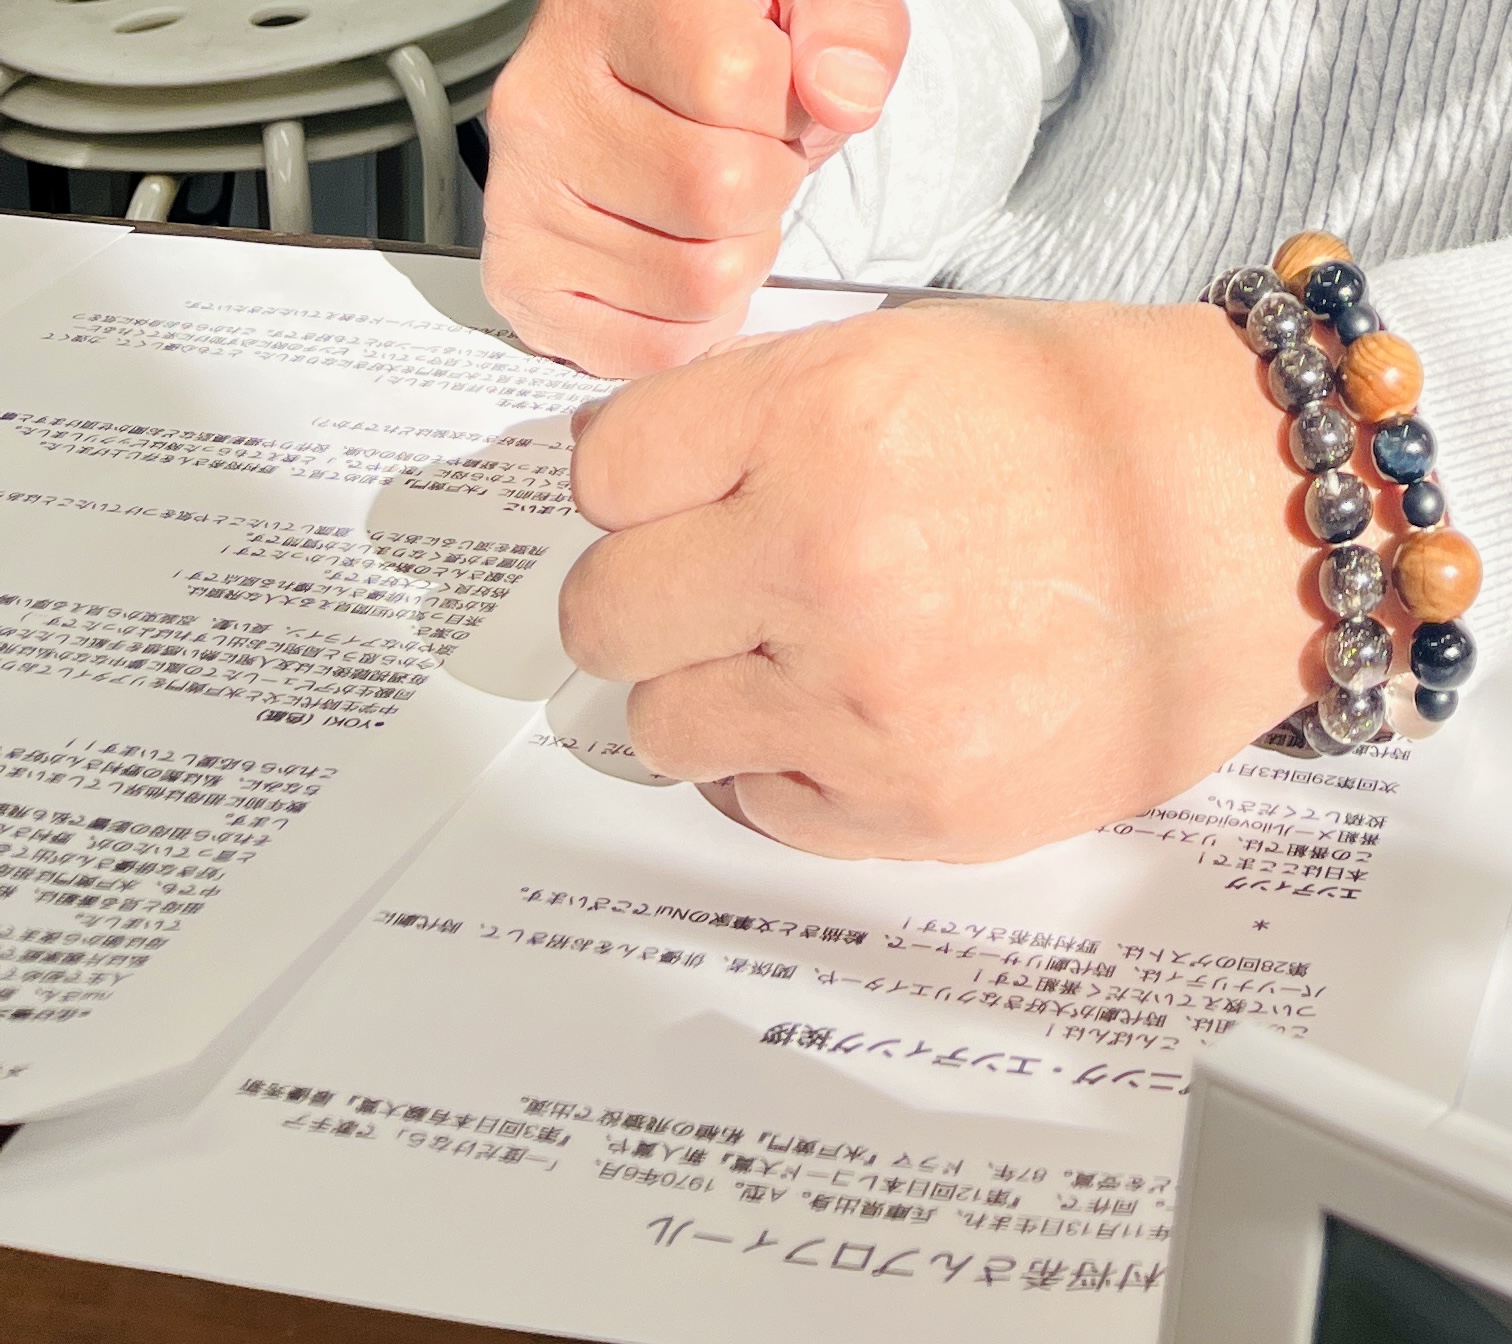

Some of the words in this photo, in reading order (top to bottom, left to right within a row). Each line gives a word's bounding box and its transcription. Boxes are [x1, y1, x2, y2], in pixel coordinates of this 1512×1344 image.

[1225, 874, 1363, 903] エンディング
